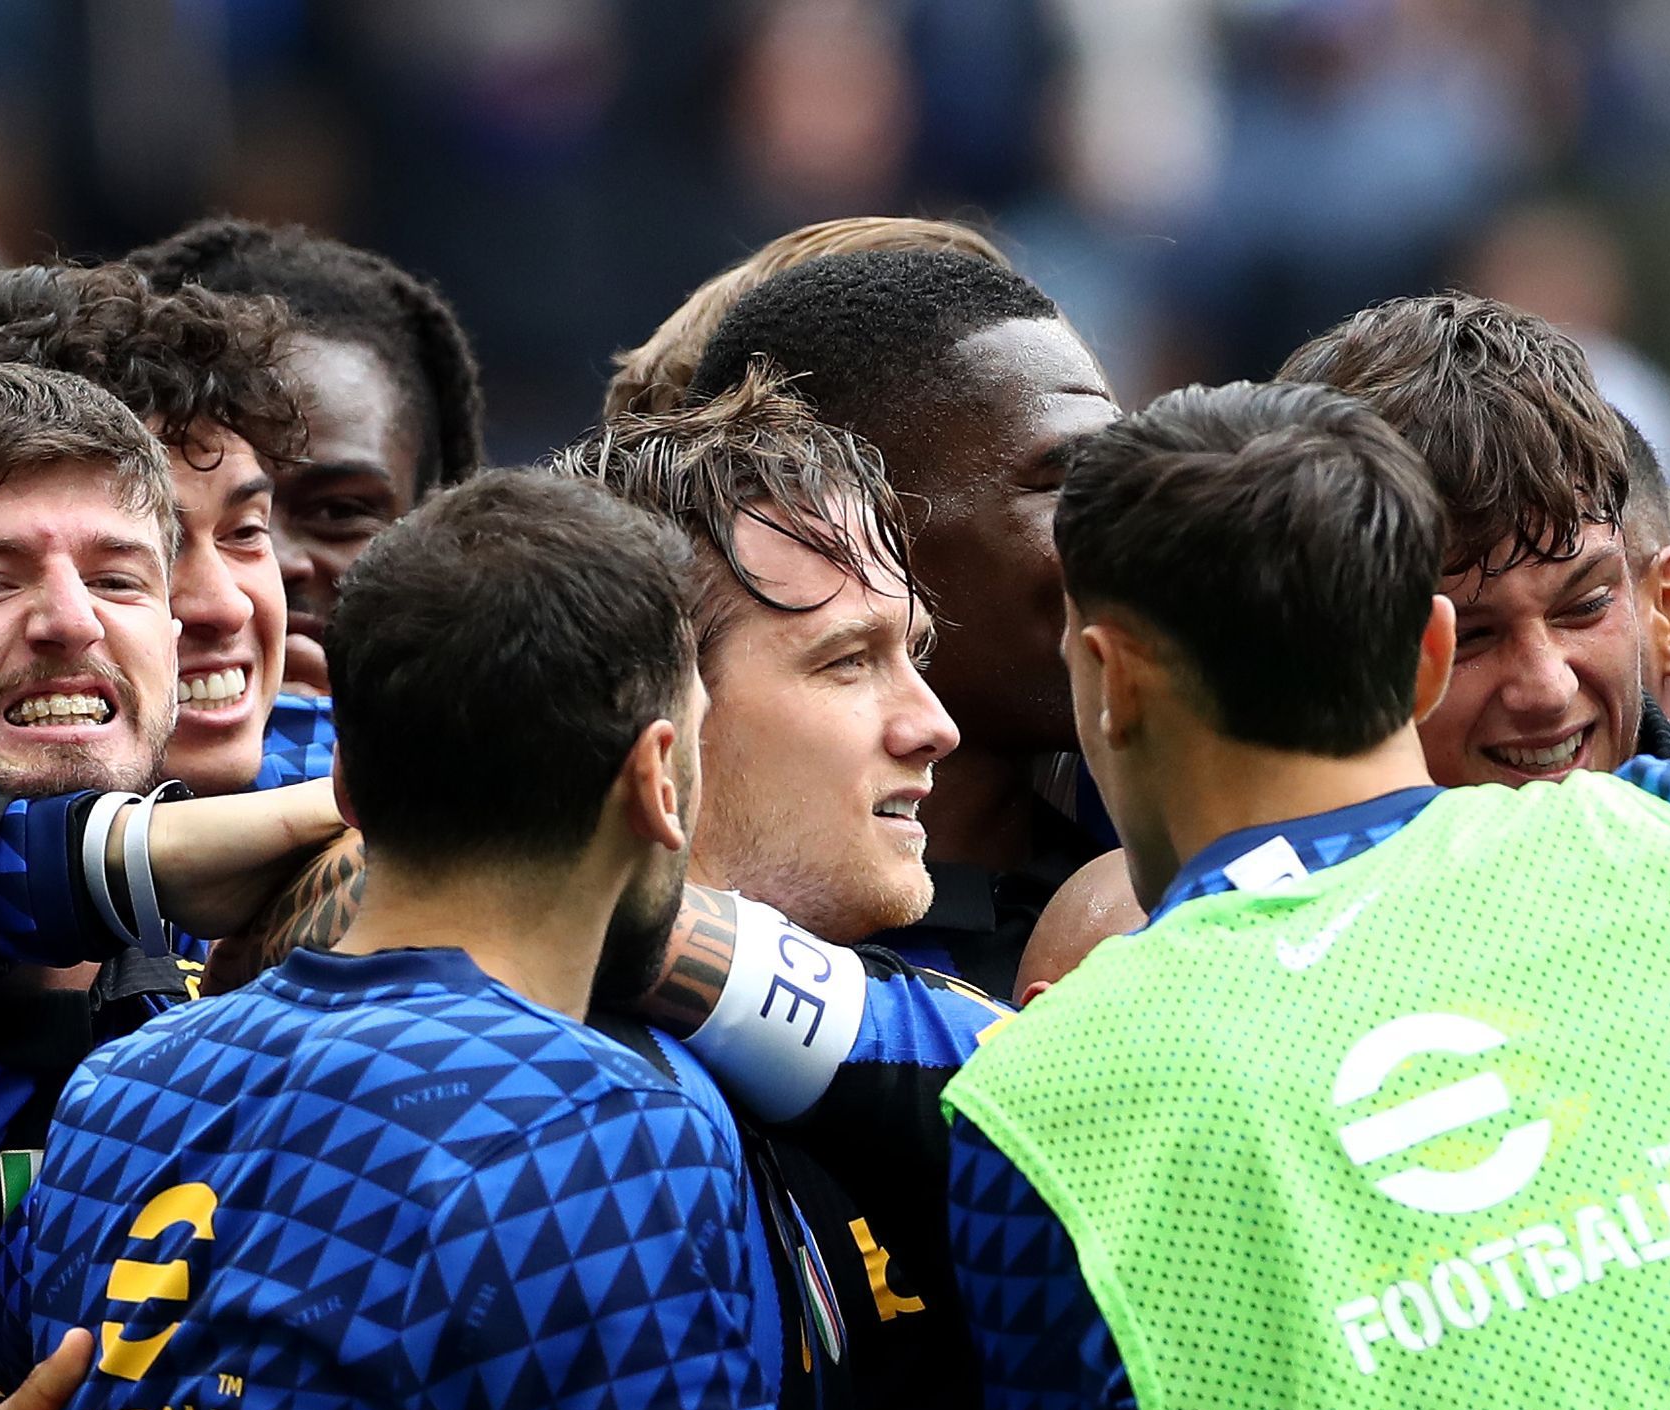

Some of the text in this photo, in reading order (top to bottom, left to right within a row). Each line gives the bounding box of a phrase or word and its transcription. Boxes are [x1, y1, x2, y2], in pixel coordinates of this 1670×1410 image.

[759, 930, 832, 1048] CE
[392, 1080, 472, 1111] INTER
[217, 1373, 244, 1398] TM
